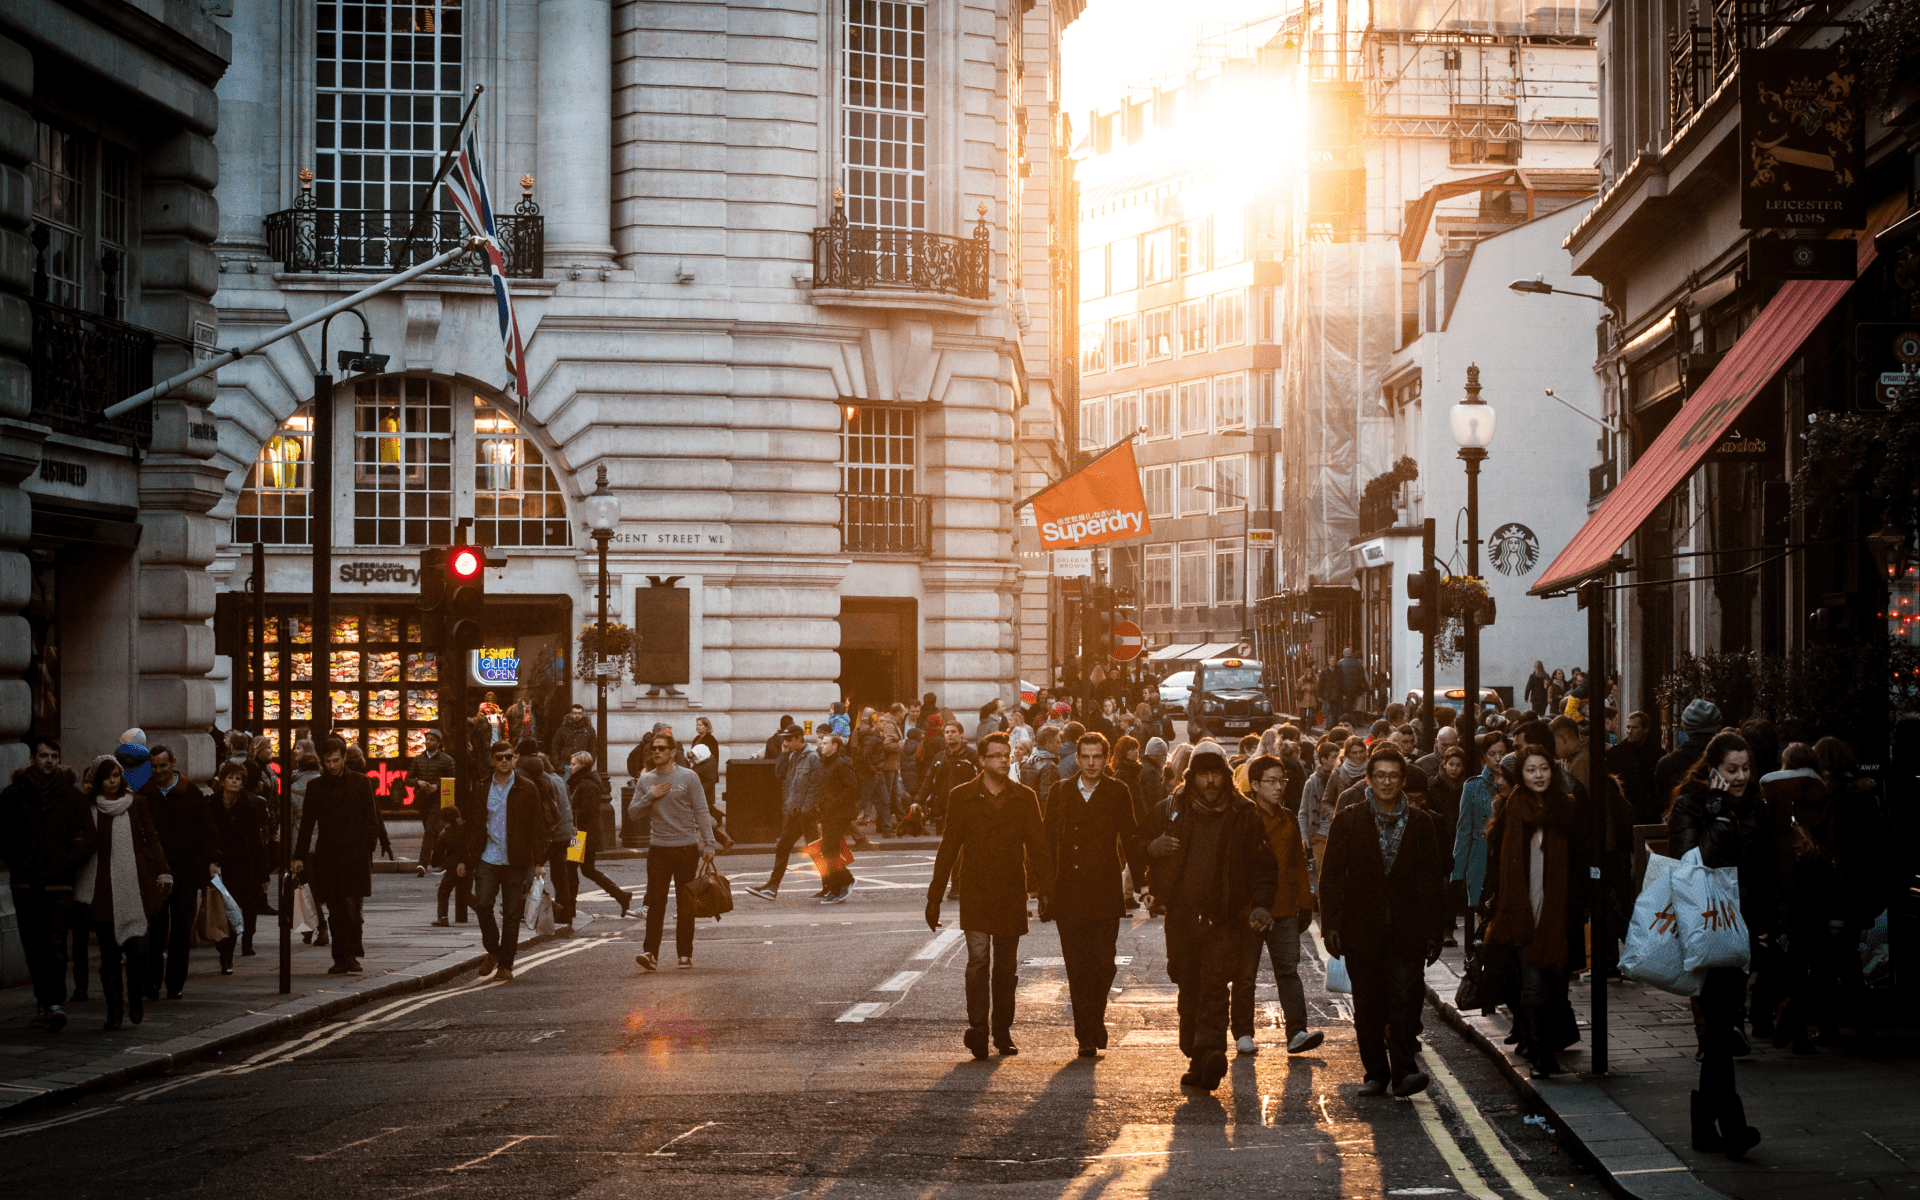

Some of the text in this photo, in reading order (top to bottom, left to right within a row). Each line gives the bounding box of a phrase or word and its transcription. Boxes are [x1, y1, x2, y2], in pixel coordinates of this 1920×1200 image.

[1766, 200, 1843, 210] LEICESTER
[1785, 213, 1826, 223] ARMS
[1042, 509, 1143, 543] Superdry
[609, 533, 648, 543] GENT
[658, 534, 701, 544] STREET
[1019, 551, 1044, 559] EIS
[340, 564, 420, 587] Superdry
[1700, 897, 1739, 933] H&M
